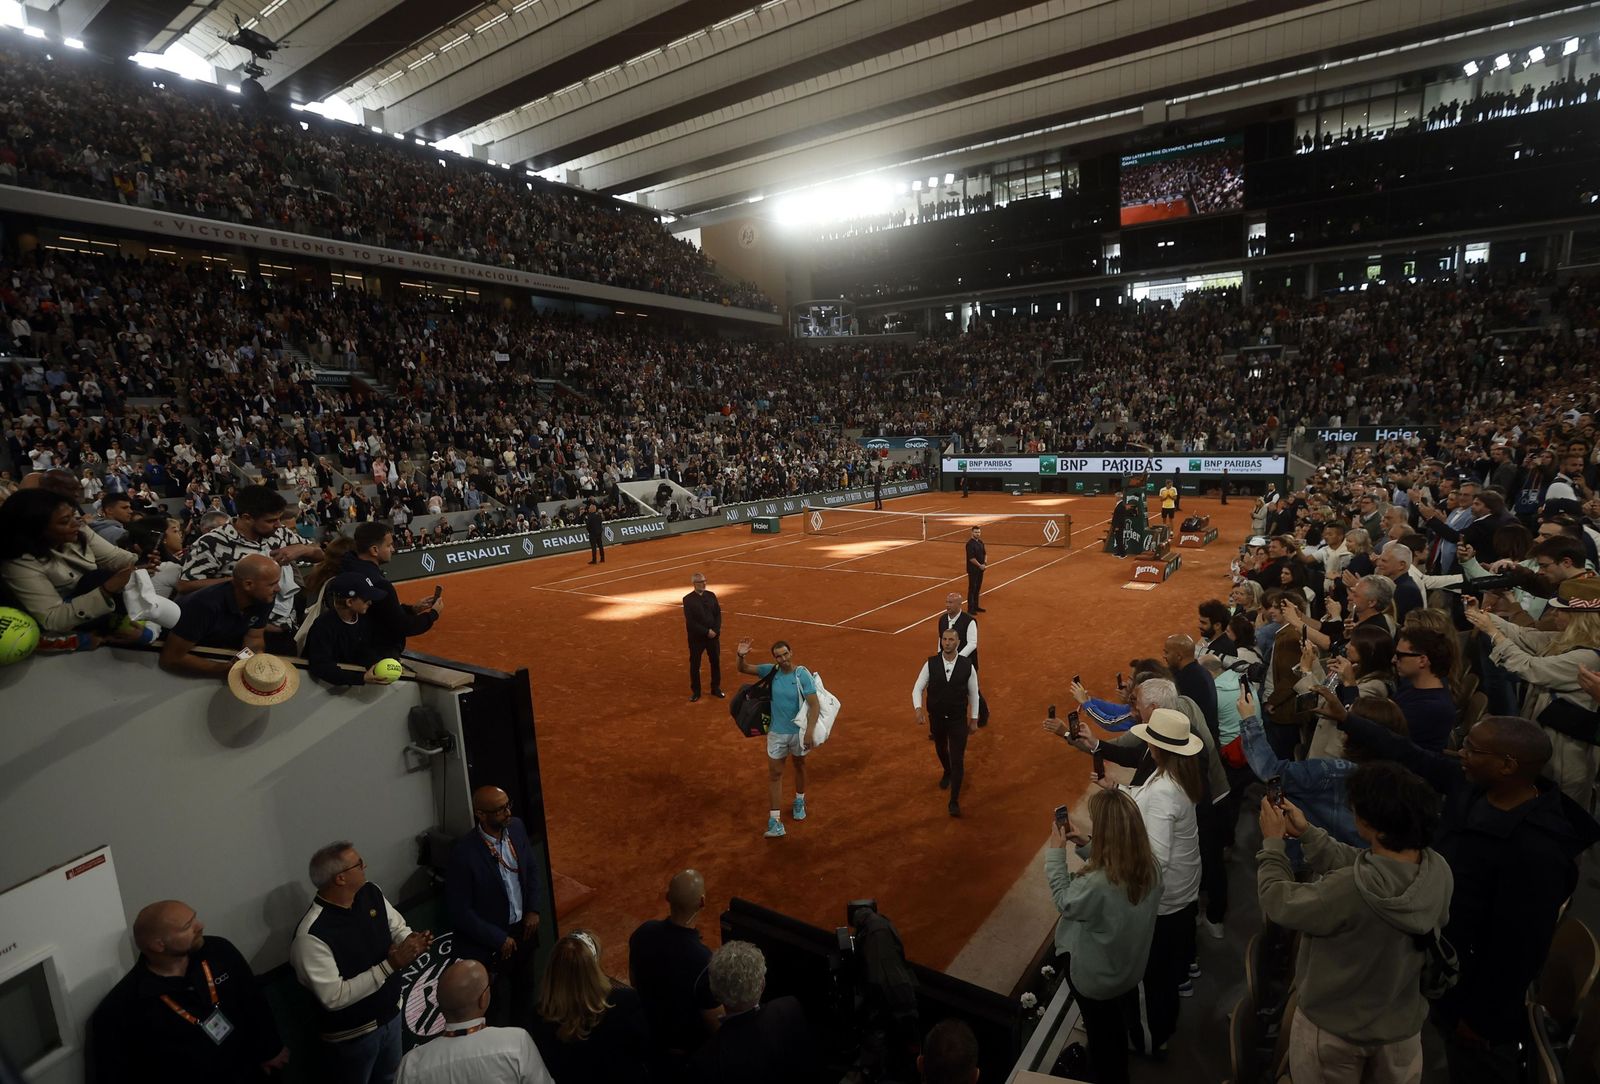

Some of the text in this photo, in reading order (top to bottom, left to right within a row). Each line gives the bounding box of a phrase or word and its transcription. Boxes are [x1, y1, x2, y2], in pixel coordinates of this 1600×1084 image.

[173, 220, 259, 243] VICTORY
[270, 236, 345, 256] BELONGS
[353, 249, 371, 260] TO
[378, 253, 405, 265] THE
[412, 259, 447, 272] MOST
[453, 265, 520, 283] TENACIOUS
[1317, 429, 1358, 442] Haier
[1060, 459, 1163, 472] BNP PARIBAS
[1224, 459, 1262, 467] PARIBAS
[620, 521, 666, 537] RENAULT
[753, 522, 769, 530] Haier
[542, 534, 591, 548] RENAUL
[445, 544, 511, 565] RENAULT
